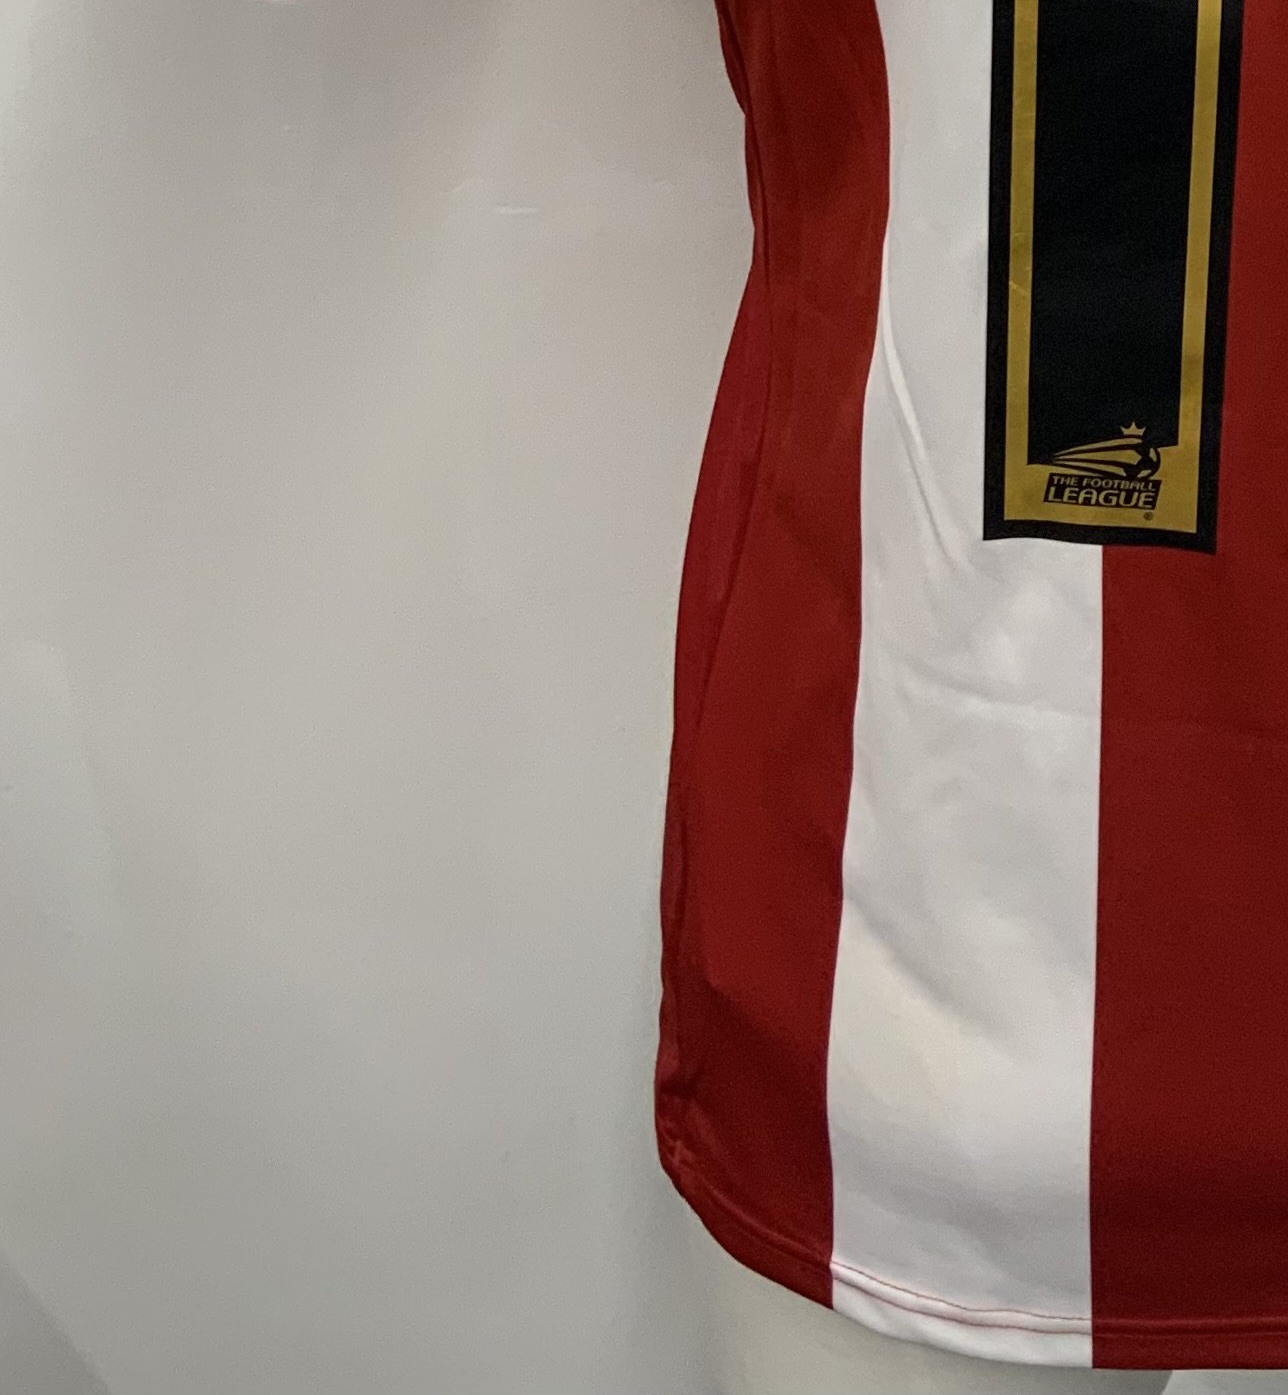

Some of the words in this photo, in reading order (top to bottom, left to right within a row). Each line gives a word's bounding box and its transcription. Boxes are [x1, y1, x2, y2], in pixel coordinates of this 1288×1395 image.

[1052, 475, 1078, 487] THE
[1082, 477, 1156, 492] FOOTBALL
[1047, 486, 1156, 509] LEAGUE
